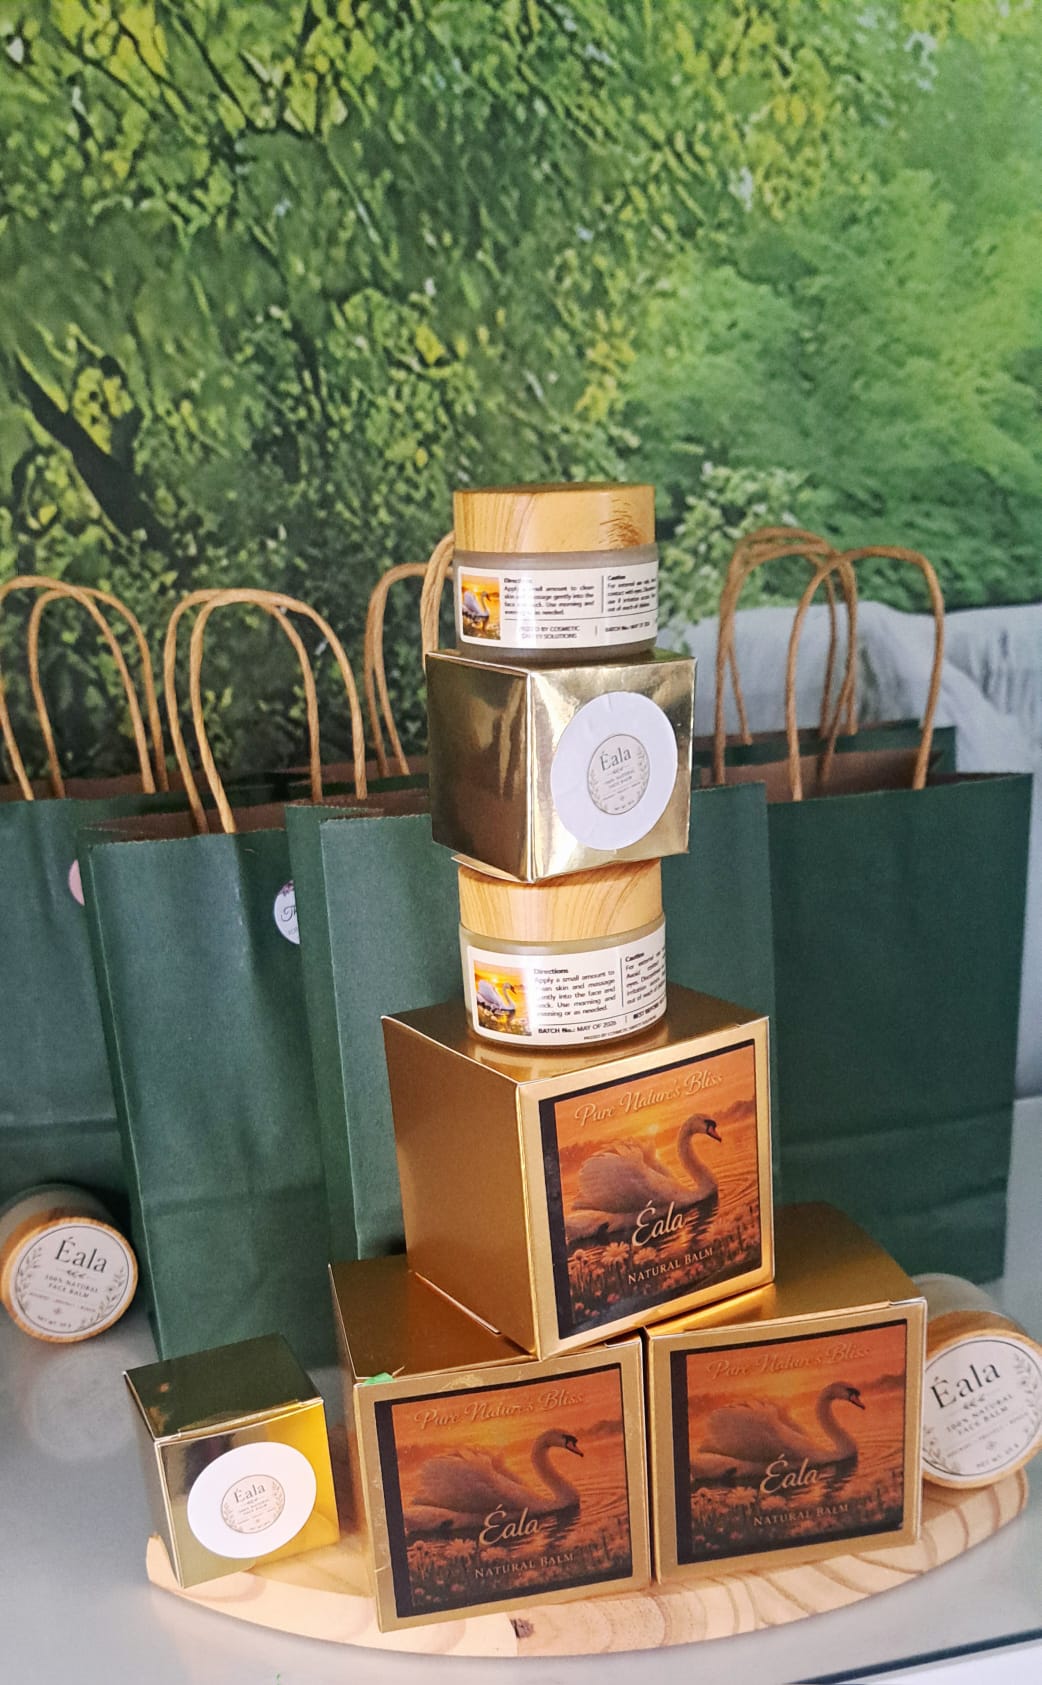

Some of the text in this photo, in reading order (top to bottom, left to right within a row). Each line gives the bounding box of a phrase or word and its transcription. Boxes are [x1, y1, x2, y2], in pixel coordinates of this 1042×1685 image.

[599, 747, 632, 772] Éala
[574, 1103, 615, 1128] Pure
[684, 1072, 723, 1096] Bliss
[631, 1200, 685, 1247] Éala
[54, 1236, 108, 1274] Éala
[628, 1248, 714, 1285] NATURAL BALM
[706, 1360, 750, 1380] Pure
[930, 1363, 1000, 1409] Éala
[414, 1408, 461, 1430] Pure
[538, 1389, 584, 1411] Bliss
[759, 1452, 818, 1494] Éala
[234, 1484, 266, 1504] Éala
[478, 1504, 541, 1546] Éala
[752, 1503, 849, 1527] NATURAL BALM
[474, 1552, 574, 1578] NATURAL BALM
